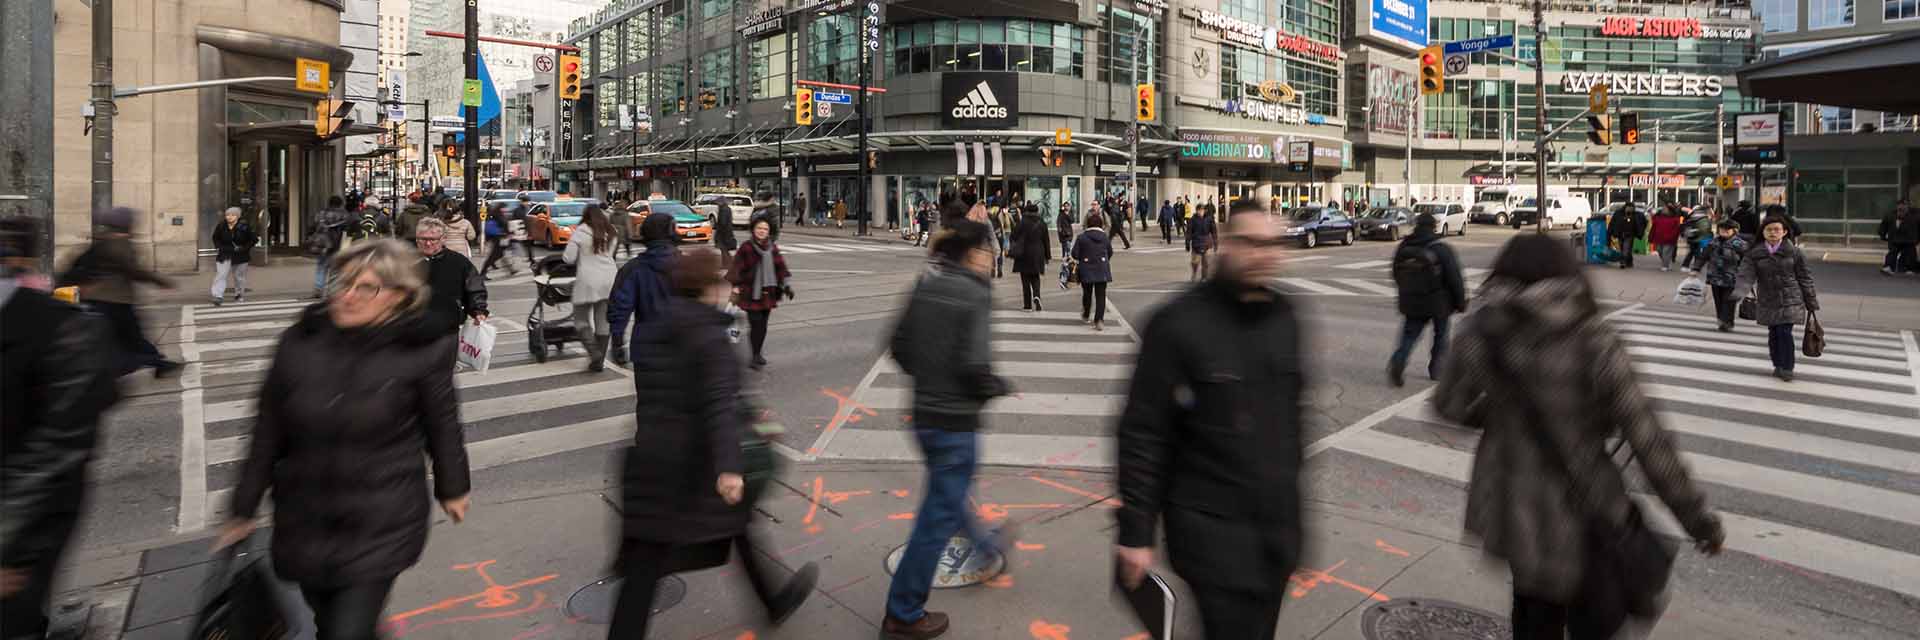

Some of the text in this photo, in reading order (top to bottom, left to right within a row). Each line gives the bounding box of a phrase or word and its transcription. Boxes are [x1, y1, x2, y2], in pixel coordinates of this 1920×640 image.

[1200, 10, 1263, 38] SHOPPERS
[1602, 15, 1637, 37] JACK
[1642, 16, 1701, 39] ASTOR'S
[1227, 31, 1246, 44] DRUG
[1460, 40, 1489, 51] Yonge
[392, 83, 401, 110] Actin
[1564, 72, 1722, 97] WINNERS
[563, 100, 571, 140] NERS
[952, 104, 1007, 119] adidas
[1247, 101, 1307, 125] CINEPLEX
[1498, 176, 1513, 185] rak
